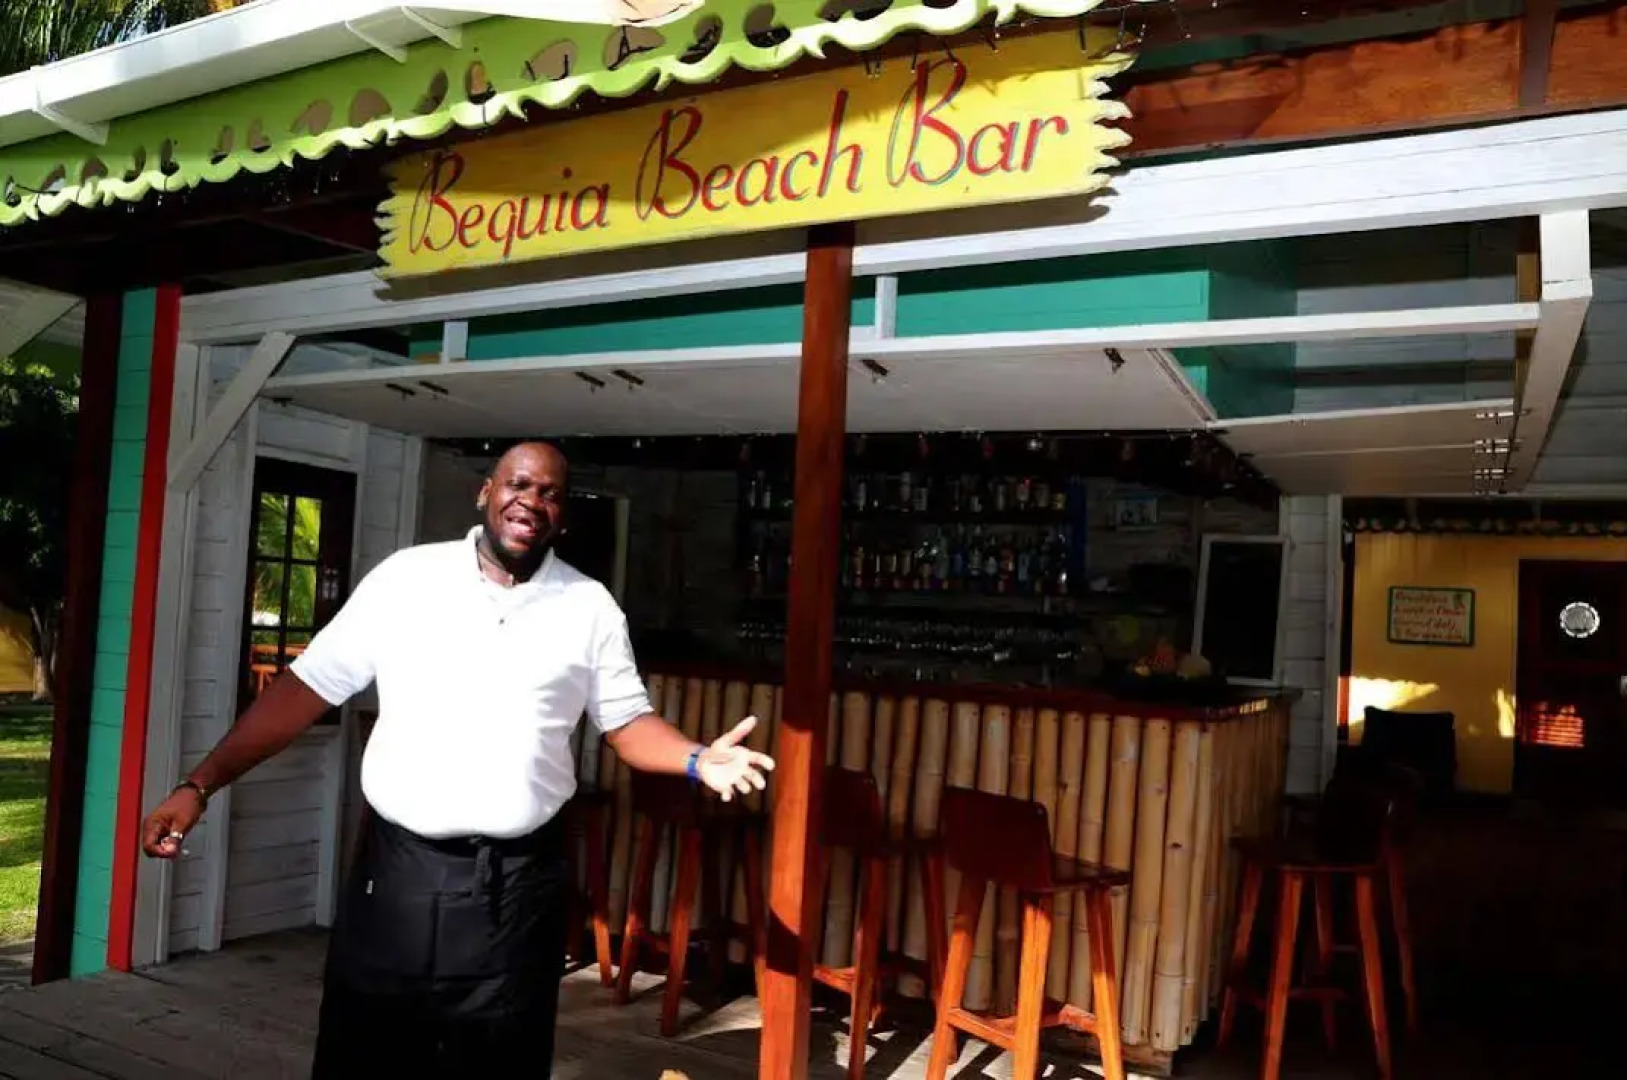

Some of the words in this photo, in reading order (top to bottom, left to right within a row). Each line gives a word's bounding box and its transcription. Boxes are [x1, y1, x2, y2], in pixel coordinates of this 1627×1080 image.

[410, 151, 611, 258] Bequia
[635, 89, 864, 221] Beach
[887, 57, 1069, 188] Bar
